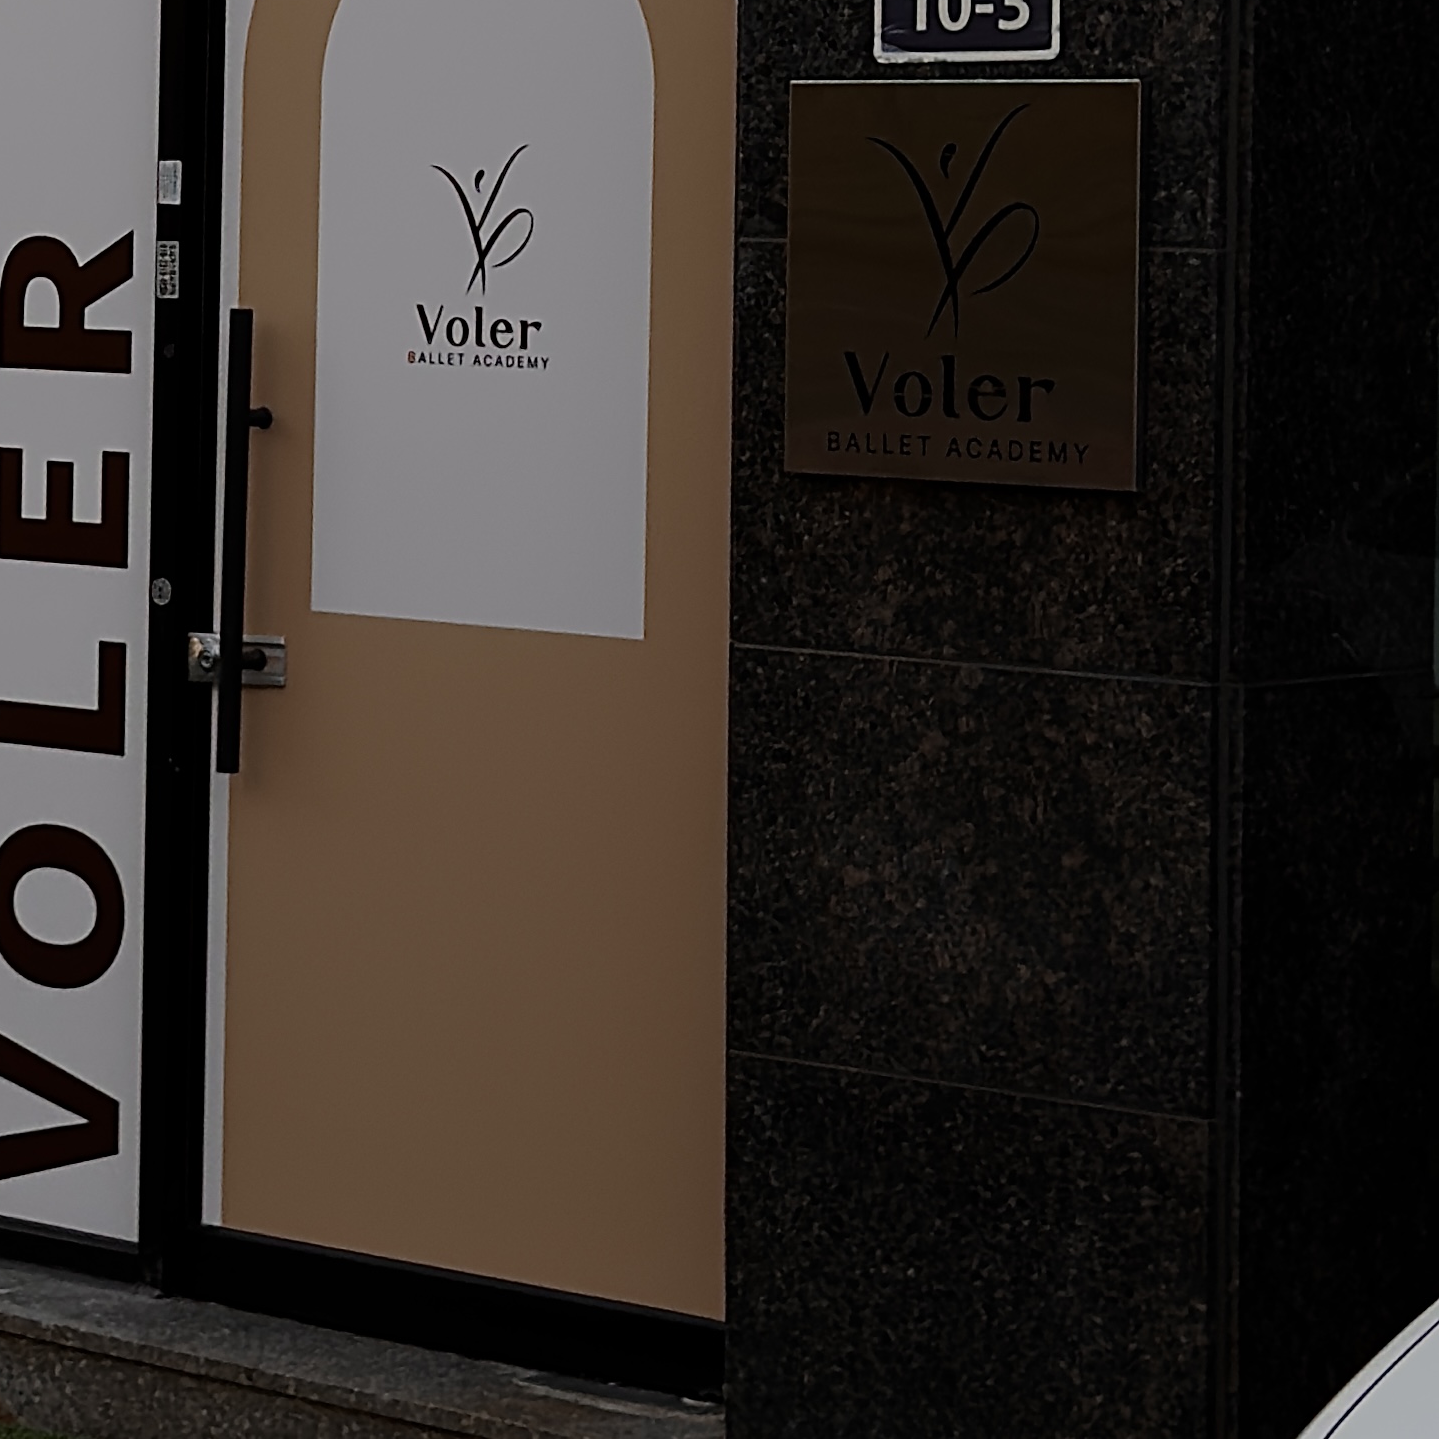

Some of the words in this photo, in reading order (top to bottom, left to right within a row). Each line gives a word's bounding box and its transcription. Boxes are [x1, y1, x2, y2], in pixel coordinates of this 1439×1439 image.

[416, 304, 542, 350] Voler
[407, 351, 465, 366] BALLET
[473, 354, 549, 370] ACADEMY
[843, 351, 1055, 423] Voler
[827, 431, 931, 457] BALLET
[945, 437, 1090, 465] ACADEMY
